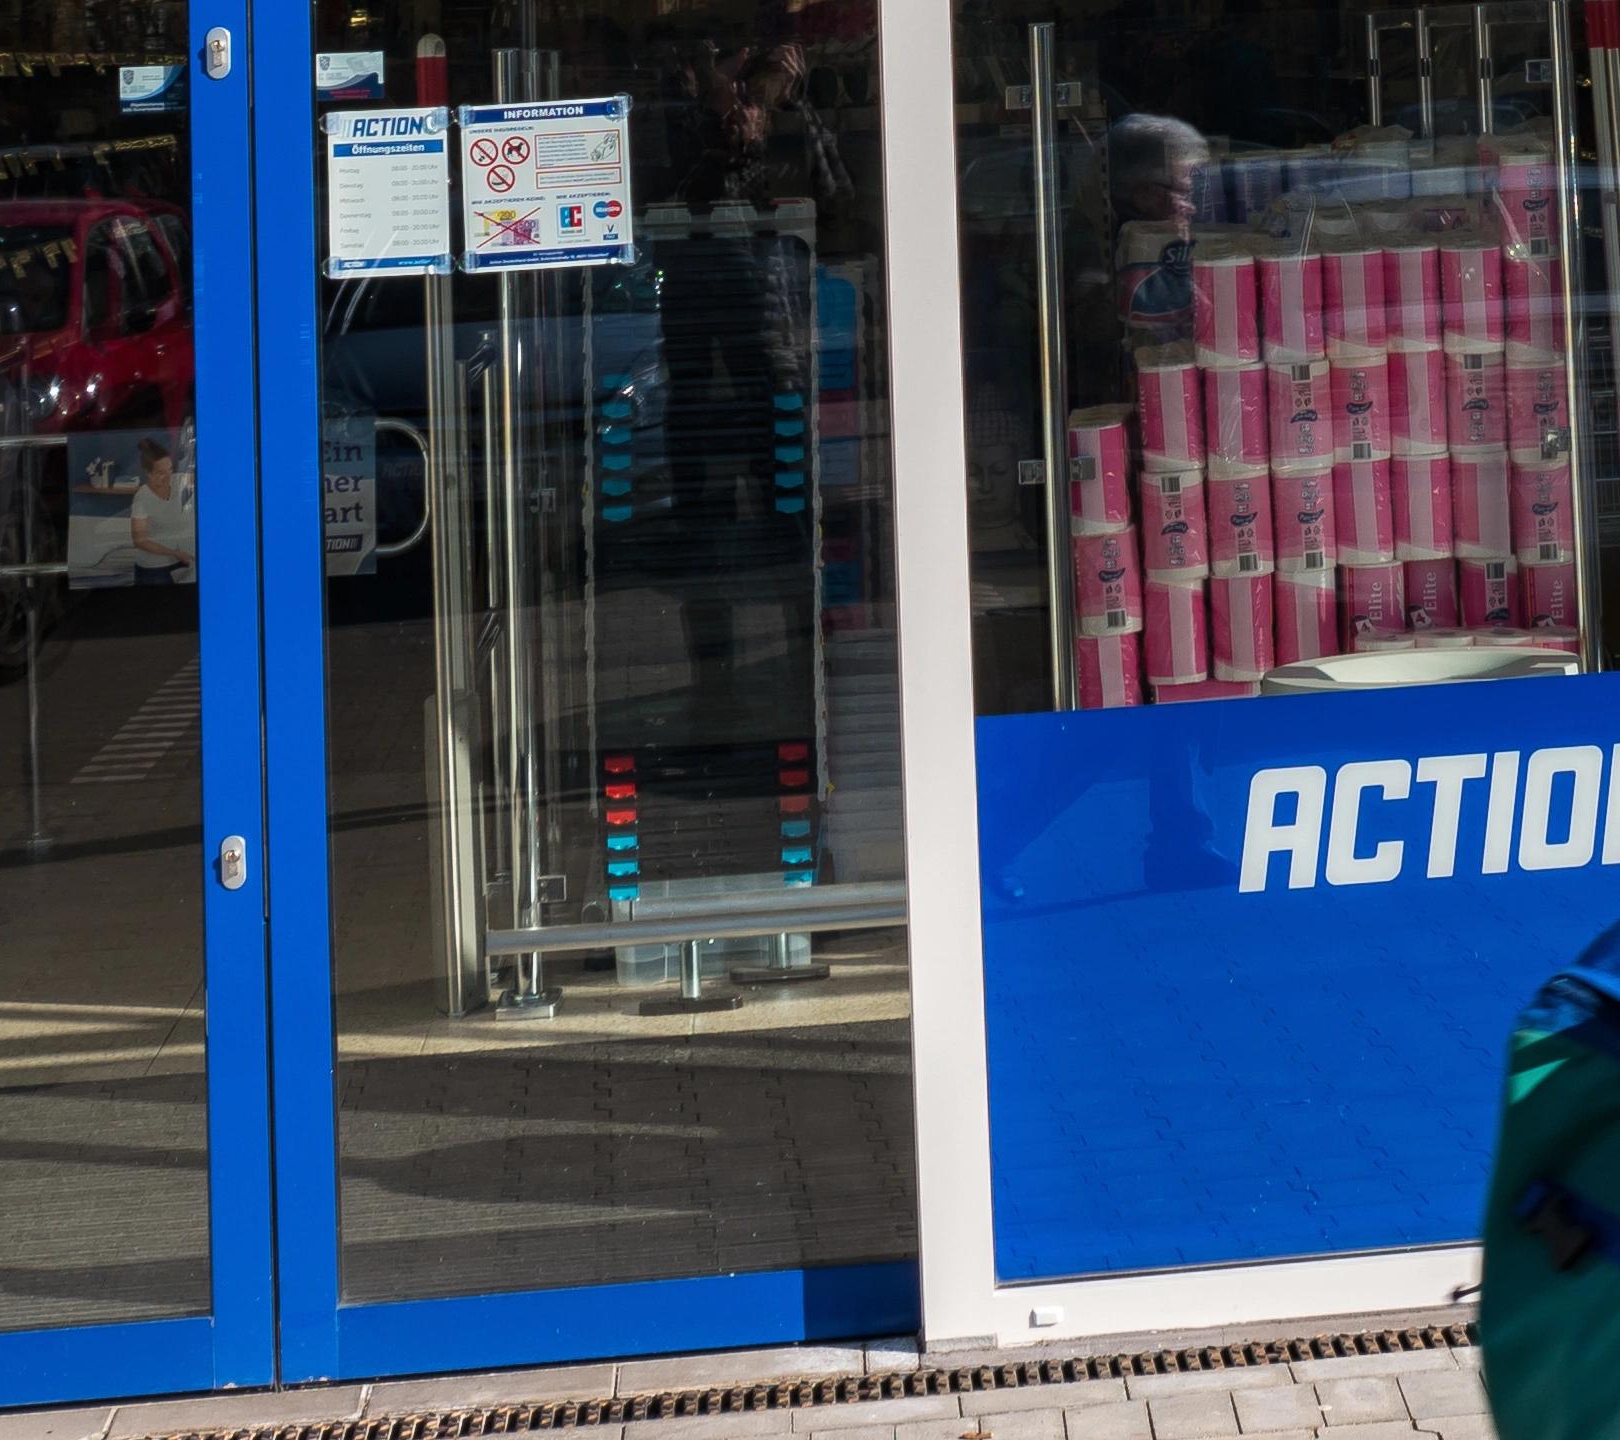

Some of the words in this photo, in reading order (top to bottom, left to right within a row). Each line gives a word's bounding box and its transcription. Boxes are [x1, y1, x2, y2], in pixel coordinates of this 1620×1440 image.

[504, 106, 584, 120] INFORMATION
[352, 116, 424, 138] ACTION
[351, 142, 425, 156] Öffnungszeiten
[324, 501, 364, 524] art
[326, 537, 351, 550] TION
[1369, 581, 1383, 621] Elite
[1422, 570, 1438, 612] Elite
[1550, 578, 1565, 621] Elite
